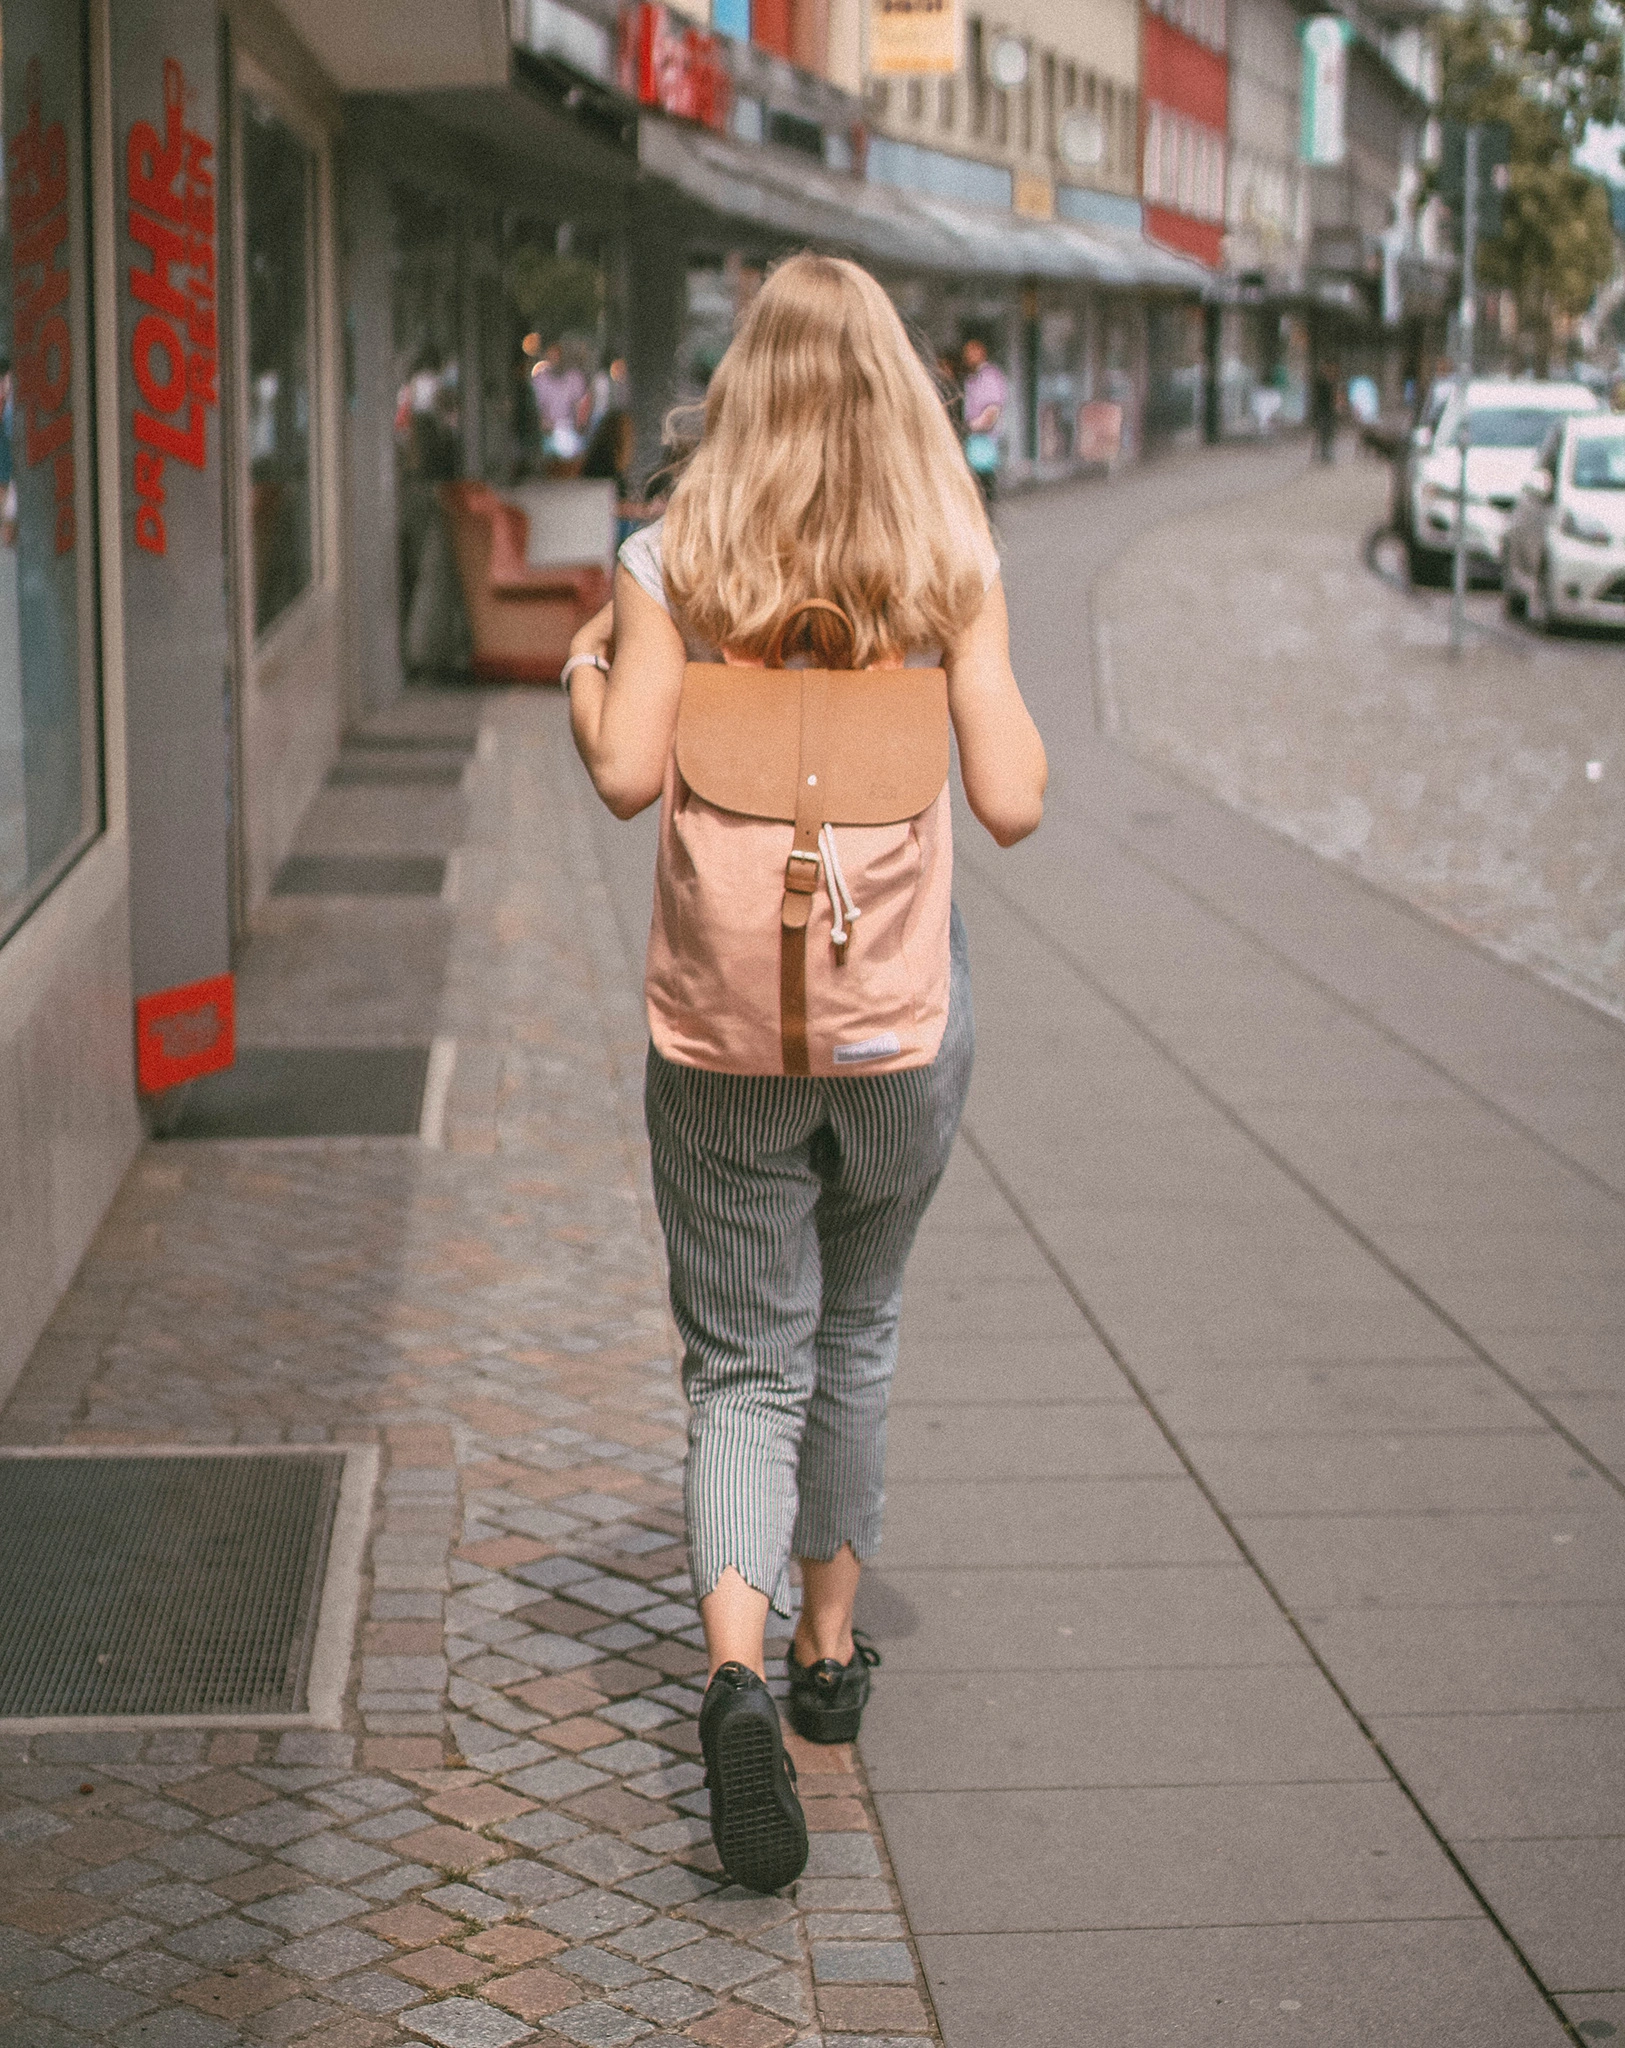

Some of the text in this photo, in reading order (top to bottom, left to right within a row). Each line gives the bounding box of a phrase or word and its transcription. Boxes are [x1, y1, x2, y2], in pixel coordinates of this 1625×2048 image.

[127, 57, 207, 557] DR LOHR
[185, 128, 218, 408] REISEN
